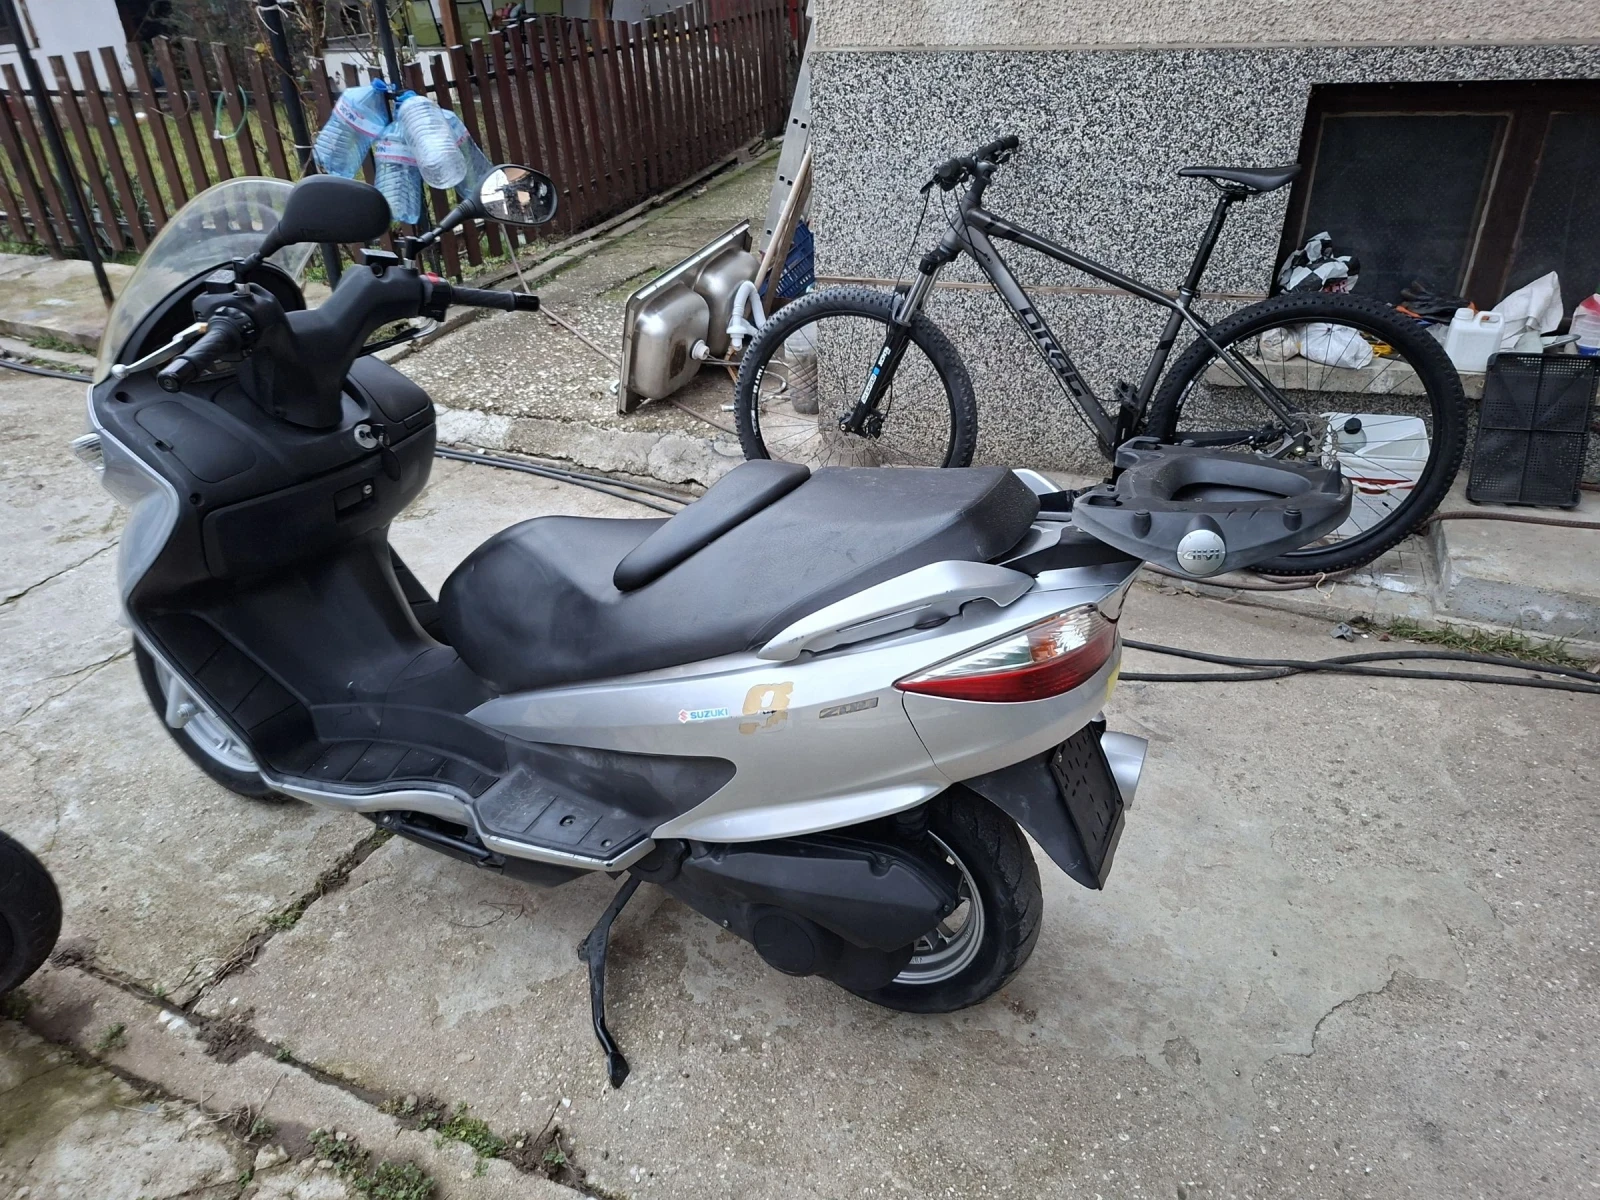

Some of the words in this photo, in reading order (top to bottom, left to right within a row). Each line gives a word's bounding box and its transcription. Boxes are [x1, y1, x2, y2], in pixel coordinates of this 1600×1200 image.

[1018, 307, 1089, 397] DRAG
[1183, 549, 1220, 560] GIVI
[690, 708, 728, 719] SUZUKI
